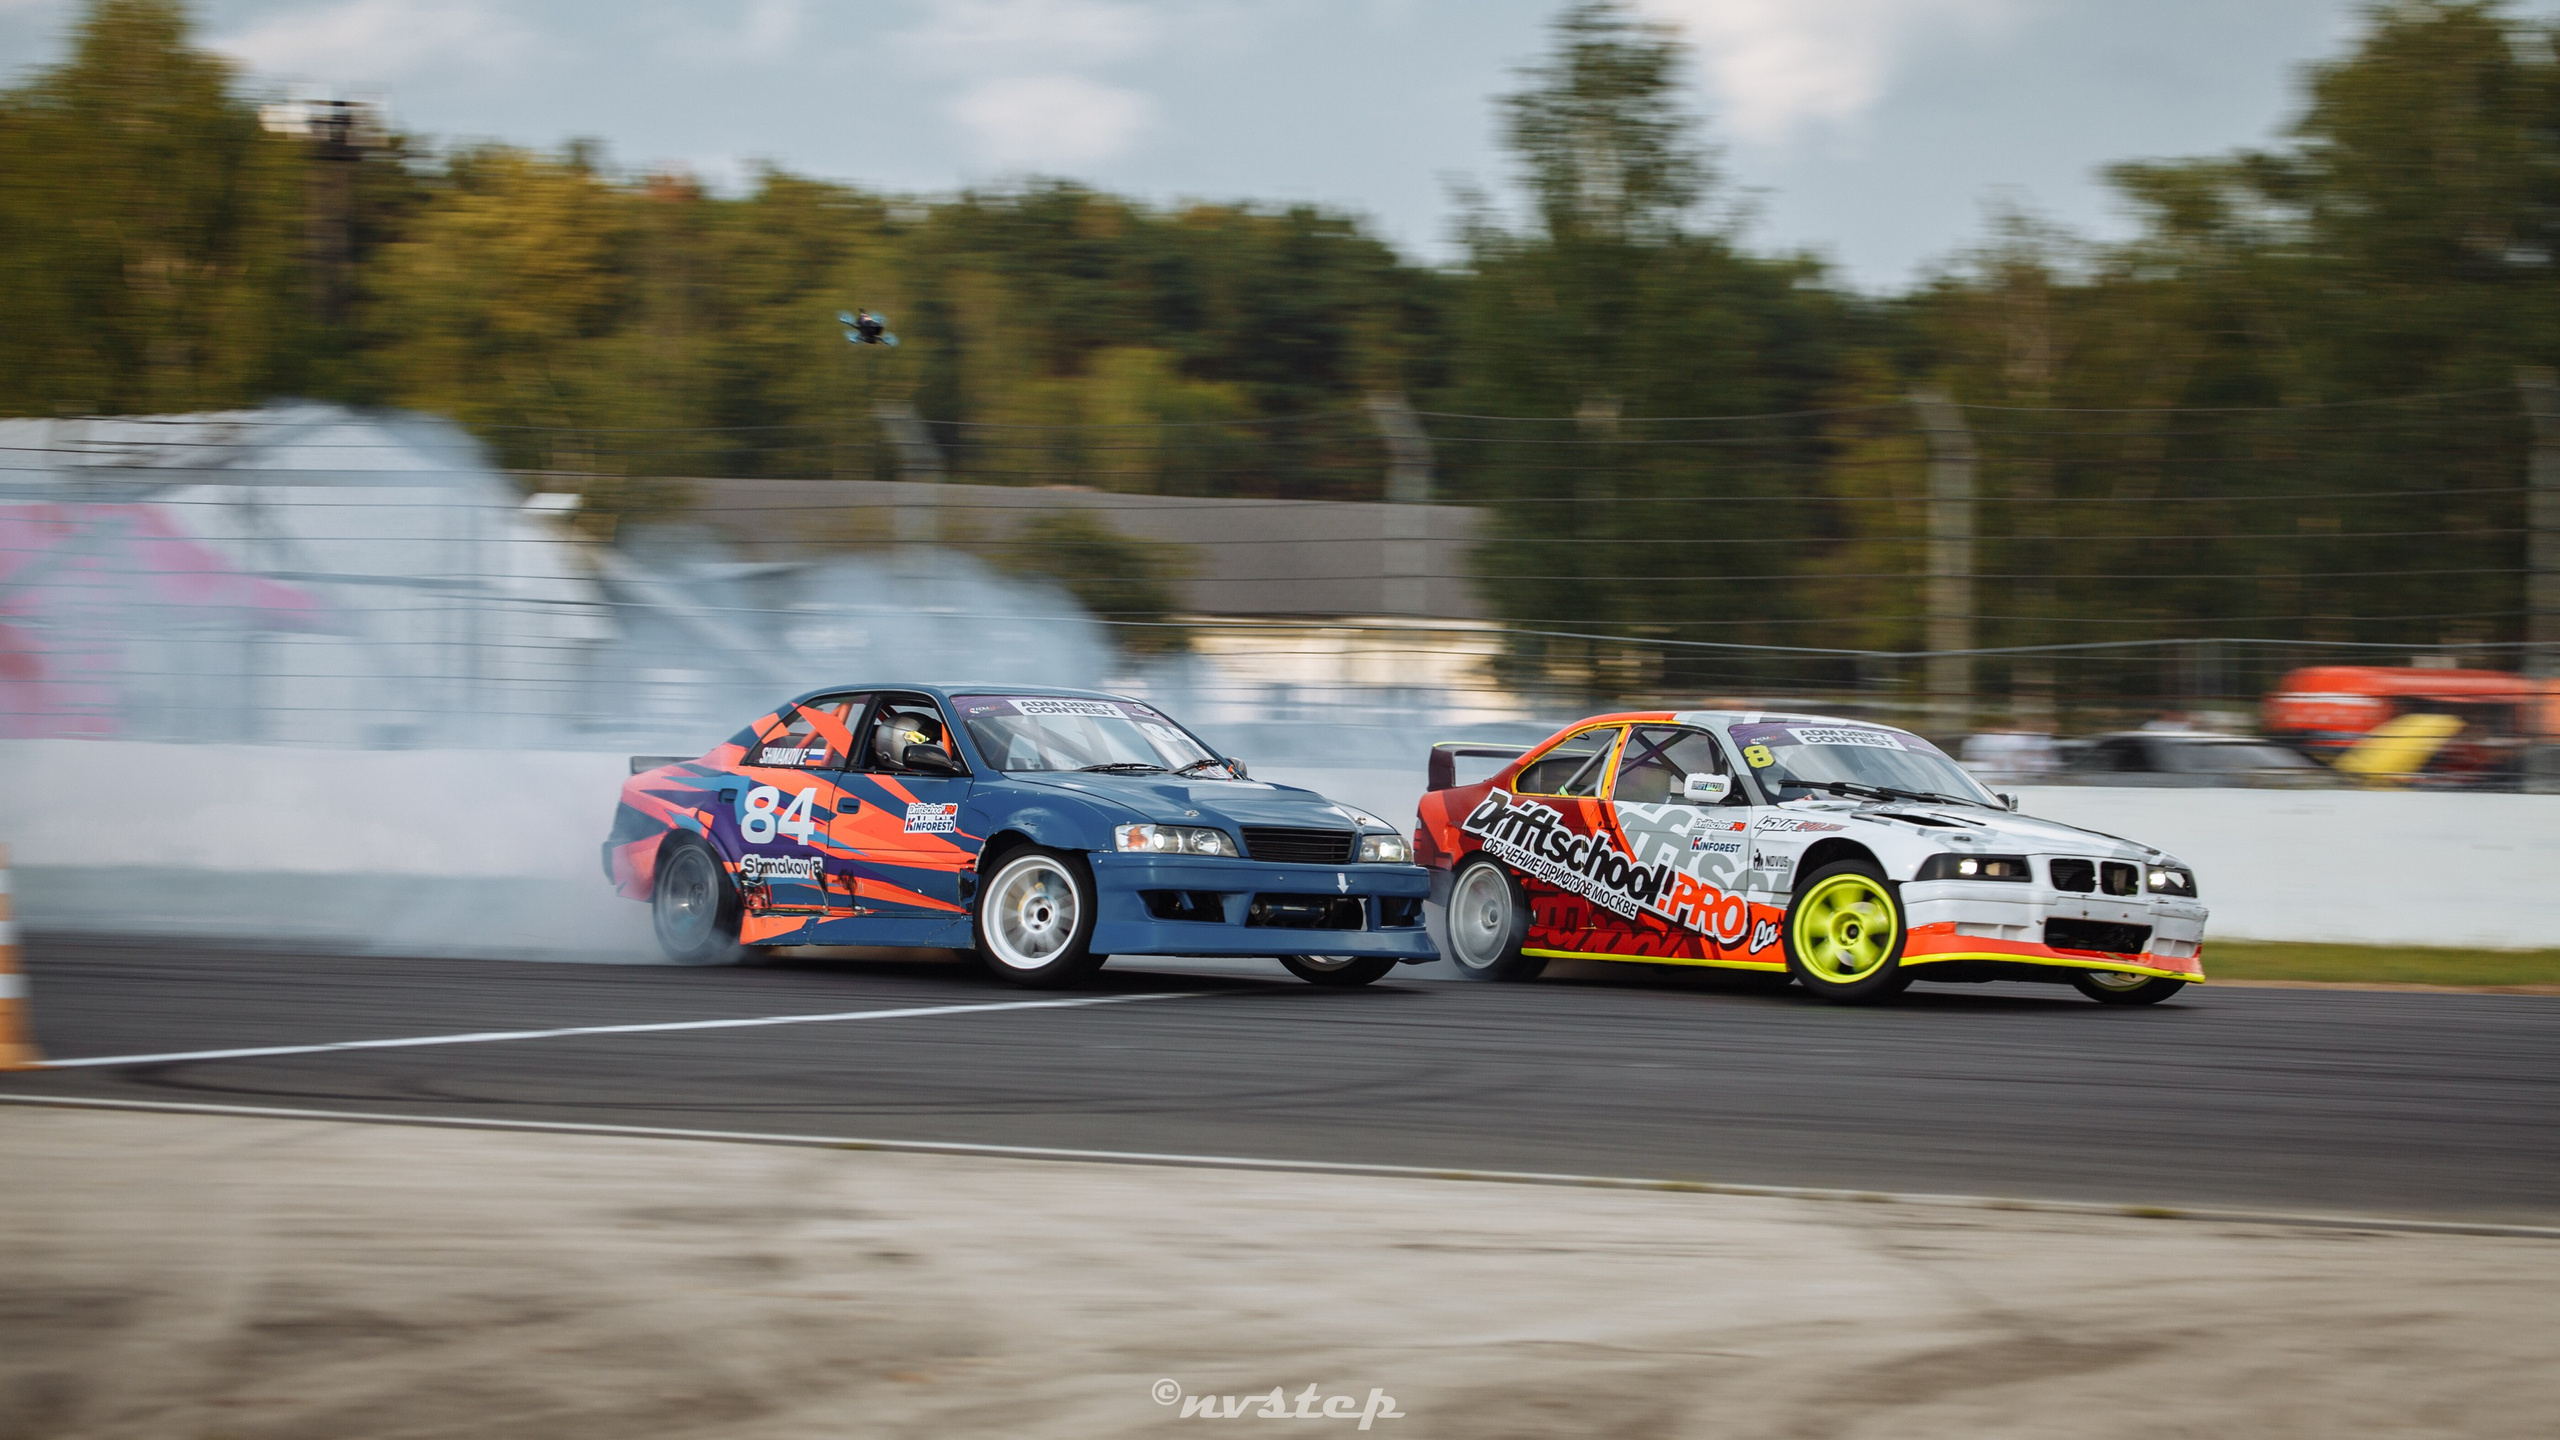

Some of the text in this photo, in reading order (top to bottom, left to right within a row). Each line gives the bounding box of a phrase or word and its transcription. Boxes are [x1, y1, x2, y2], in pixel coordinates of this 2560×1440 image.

[1026, 707, 1119, 716] CONTEST
[1062, 701, 1109, 709] DRIFT
[1805, 737, 1896, 748] CONTEST
[1840, 730, 1887, 740] DRIFT
[759, 747, 810, 765] SHMAKOV E
[1743, 744, 1776, 769] 8
[741, 785, 818, 846] 84
[744, 858, 809, 875] Shmakov
[1765, 855, 1788, 868] NOVUS
[1484, 837, 1637, 918] ОБУЧЕНИЕ ДРИФТУ В МОСКВЕ
